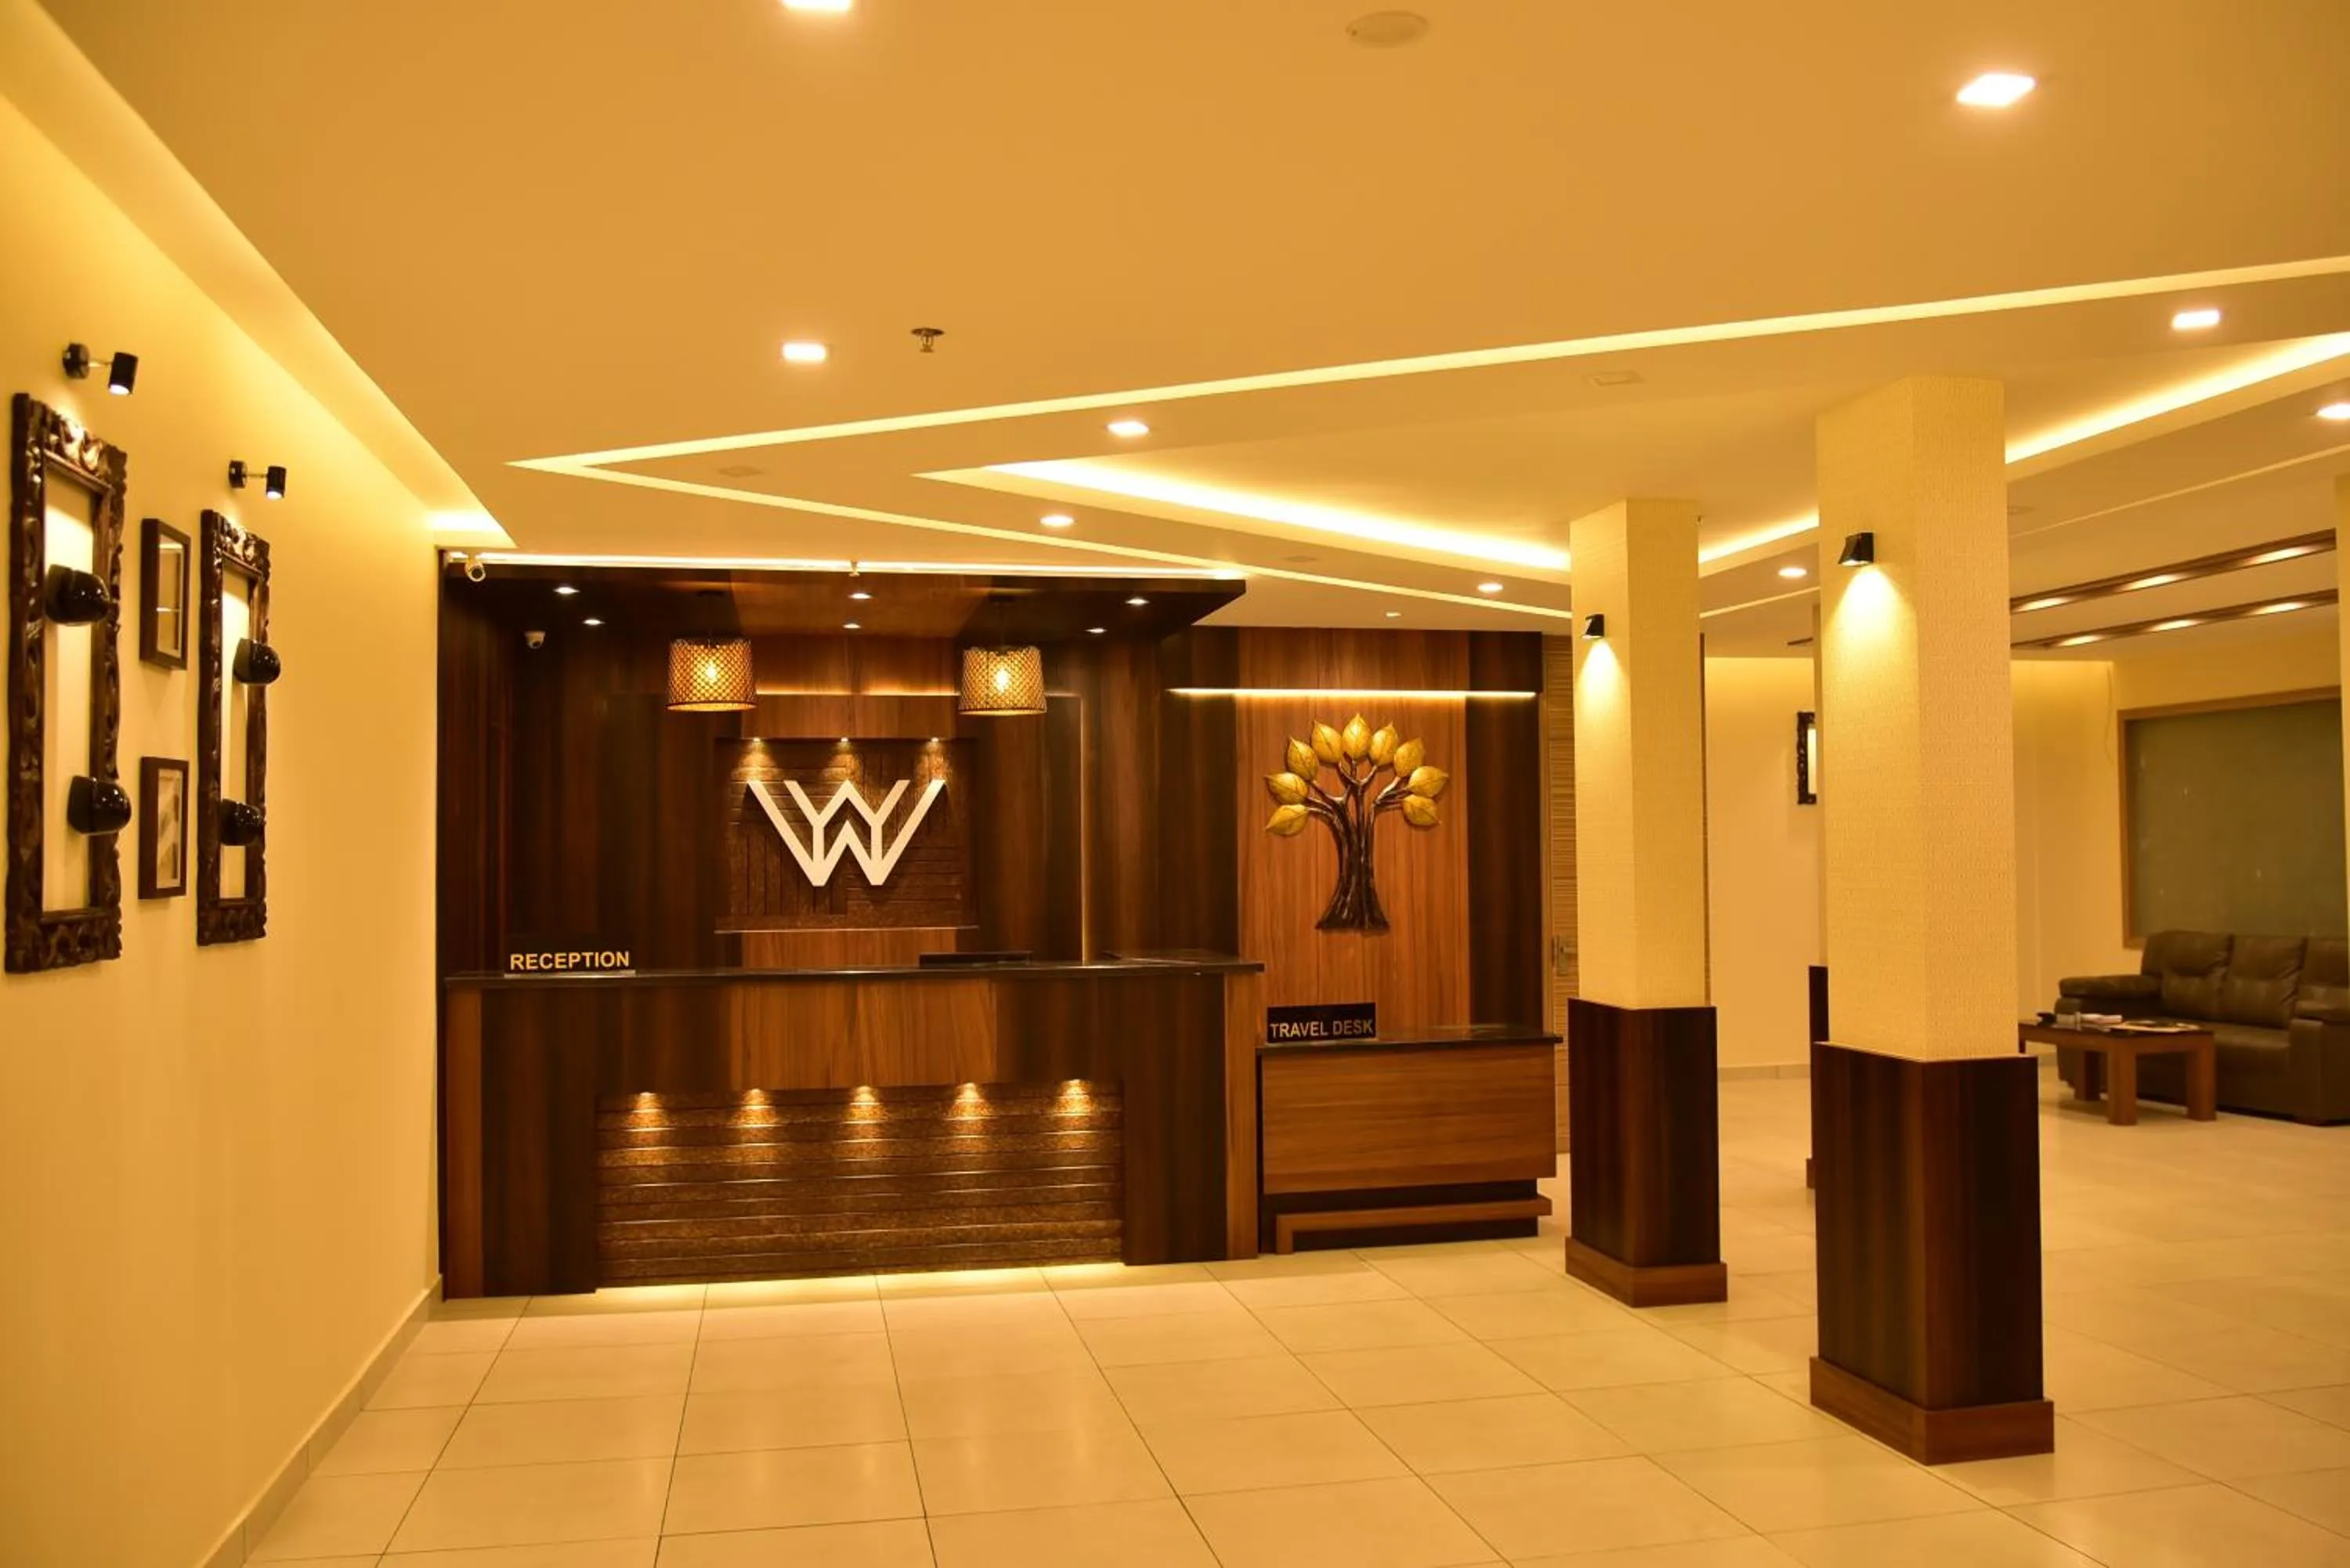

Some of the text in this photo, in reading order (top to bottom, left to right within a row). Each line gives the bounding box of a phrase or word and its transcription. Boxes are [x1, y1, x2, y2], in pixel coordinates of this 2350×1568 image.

[510, 951, 630, 970] RECEPTION
[1270, 1020, 1373, 1038] TRAVEL DESK
